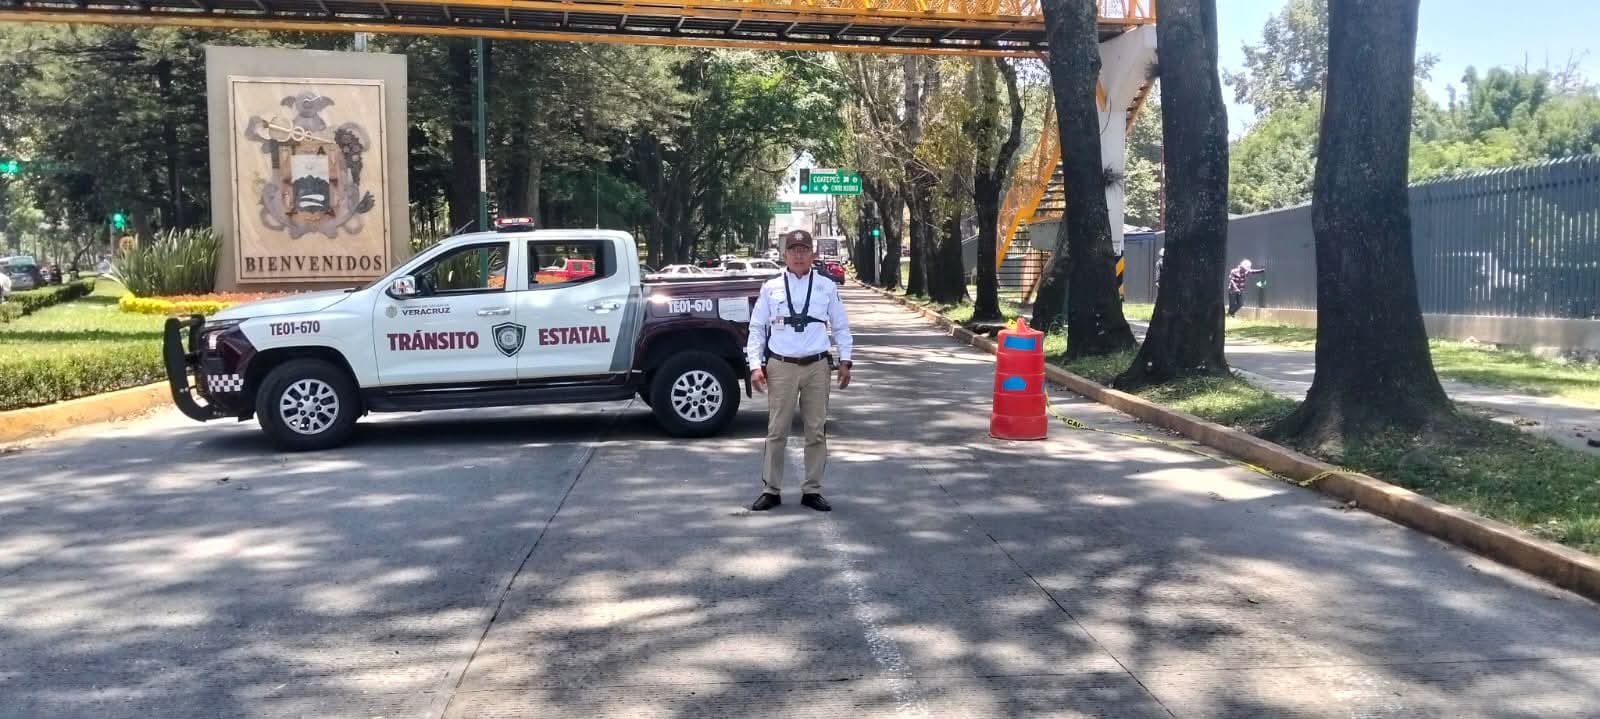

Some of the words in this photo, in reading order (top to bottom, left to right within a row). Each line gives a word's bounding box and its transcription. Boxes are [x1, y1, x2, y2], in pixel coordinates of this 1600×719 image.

[245, 255, 382, 272] BIENVENIDOS
[402, 307, 450, 316] VERACRUZ
[667, 299, 713, 313] TE01-670
[269, 320, 320, 336] TE01-670
[538, 325, 610, 346] ESTATAL
[387, 329, 479, 351] TRÁNSITO
